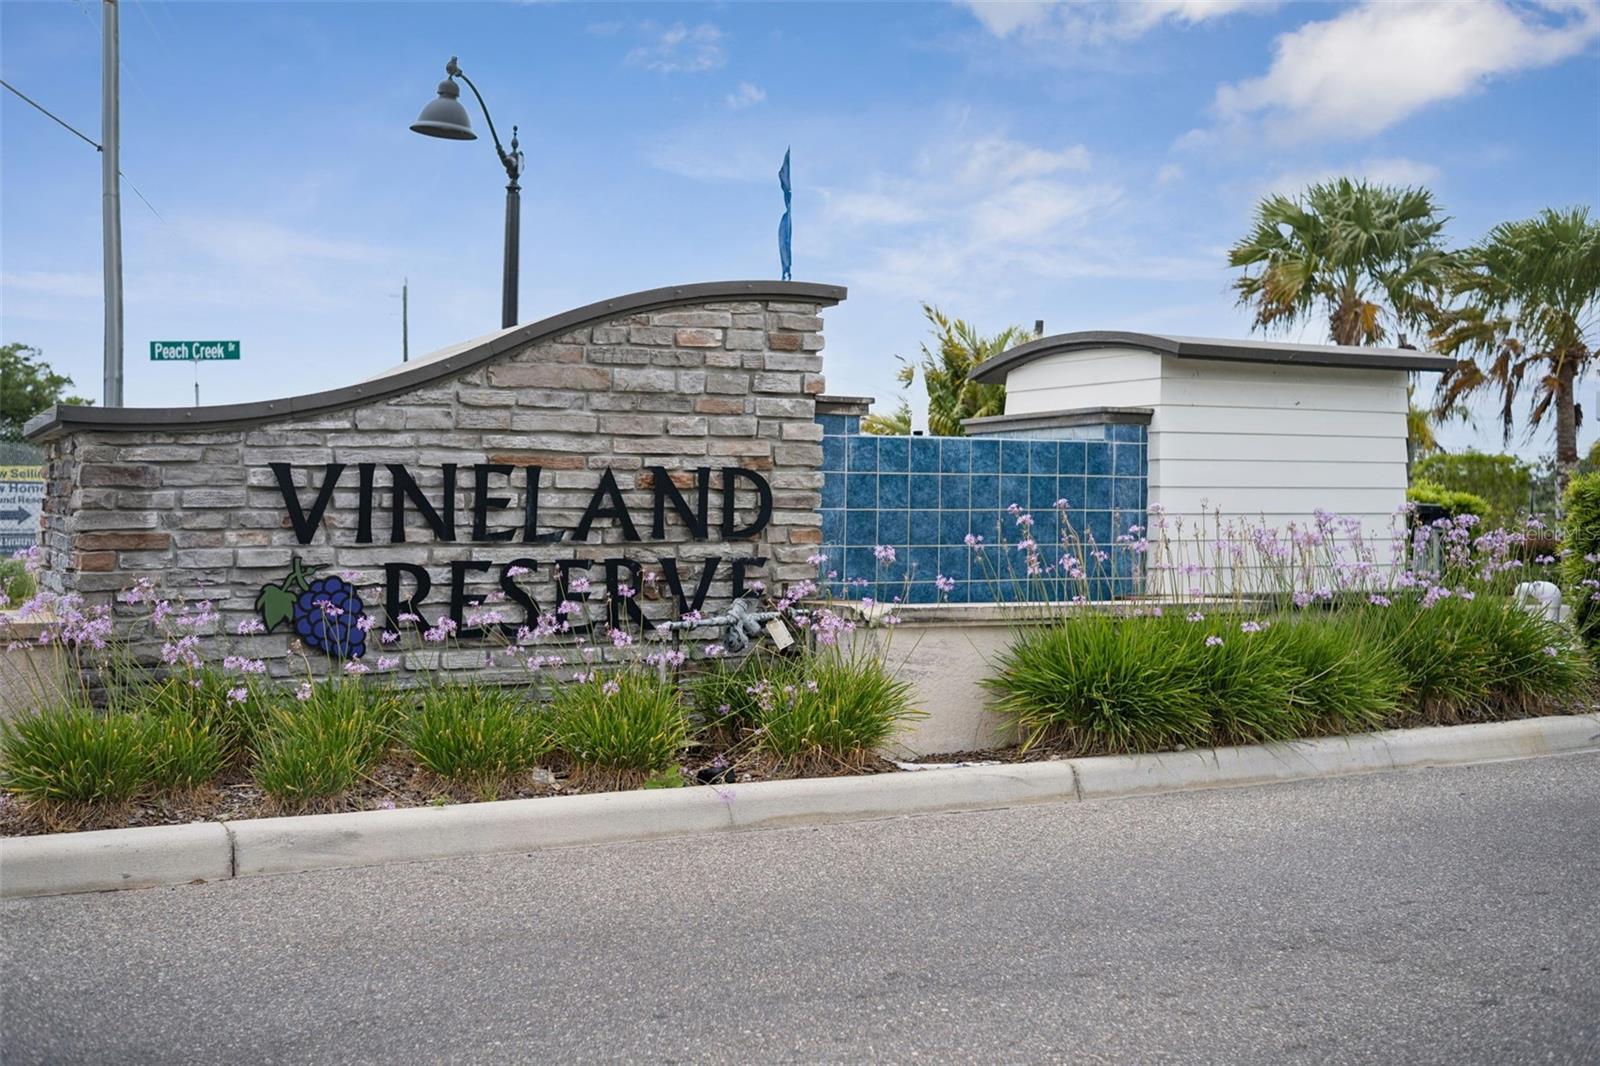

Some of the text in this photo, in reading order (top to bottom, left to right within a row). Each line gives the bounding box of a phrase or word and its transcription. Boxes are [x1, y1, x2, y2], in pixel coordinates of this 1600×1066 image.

[154, 342, 236, 359] Peach Creek Dr
[268, 462, 773, 544] VINELAND
[384, 556, 768, 641] RESERVE
